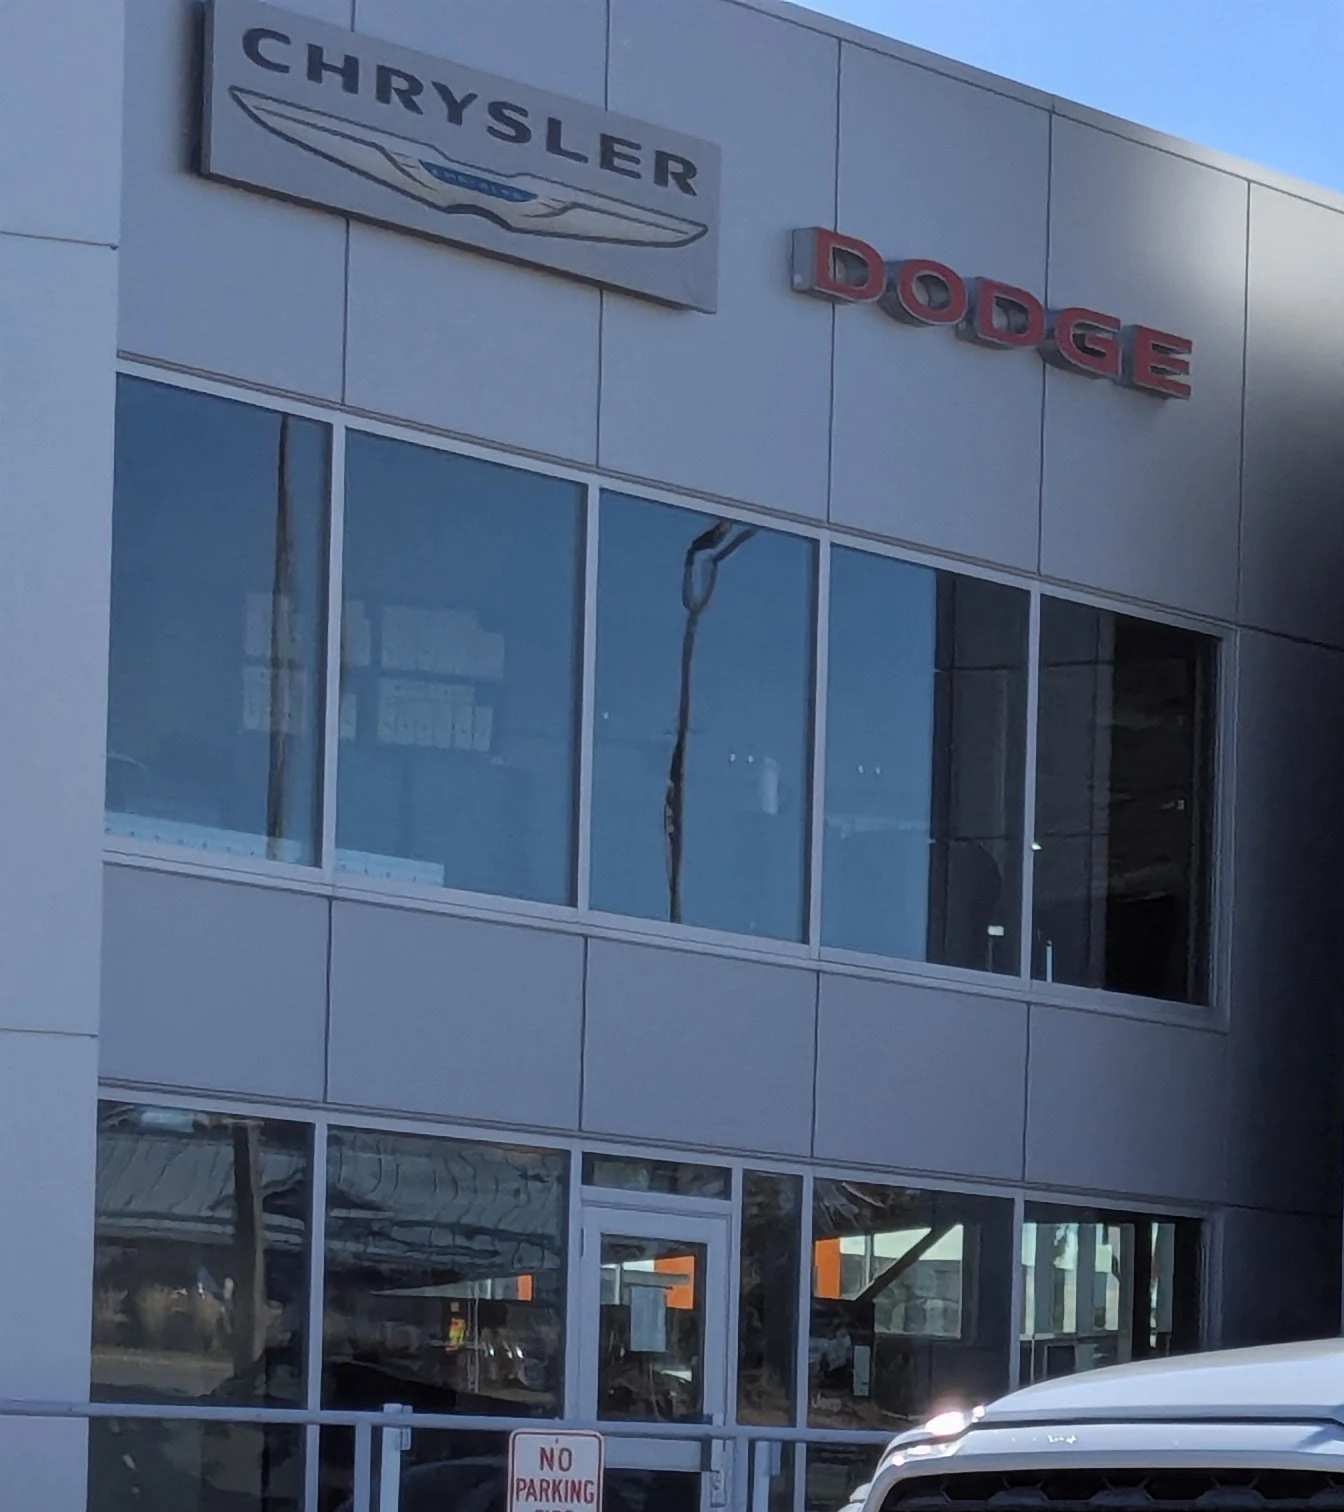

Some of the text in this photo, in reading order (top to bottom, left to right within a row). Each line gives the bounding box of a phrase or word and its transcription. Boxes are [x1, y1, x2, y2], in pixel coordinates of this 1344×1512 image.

[241, 27, 702, 197] CHRYSLER
[798, 227, 1192, 398] DODGE
[516, 1477, 595, 1504] PARKING
[539, 1446, 573, 1472] NO
